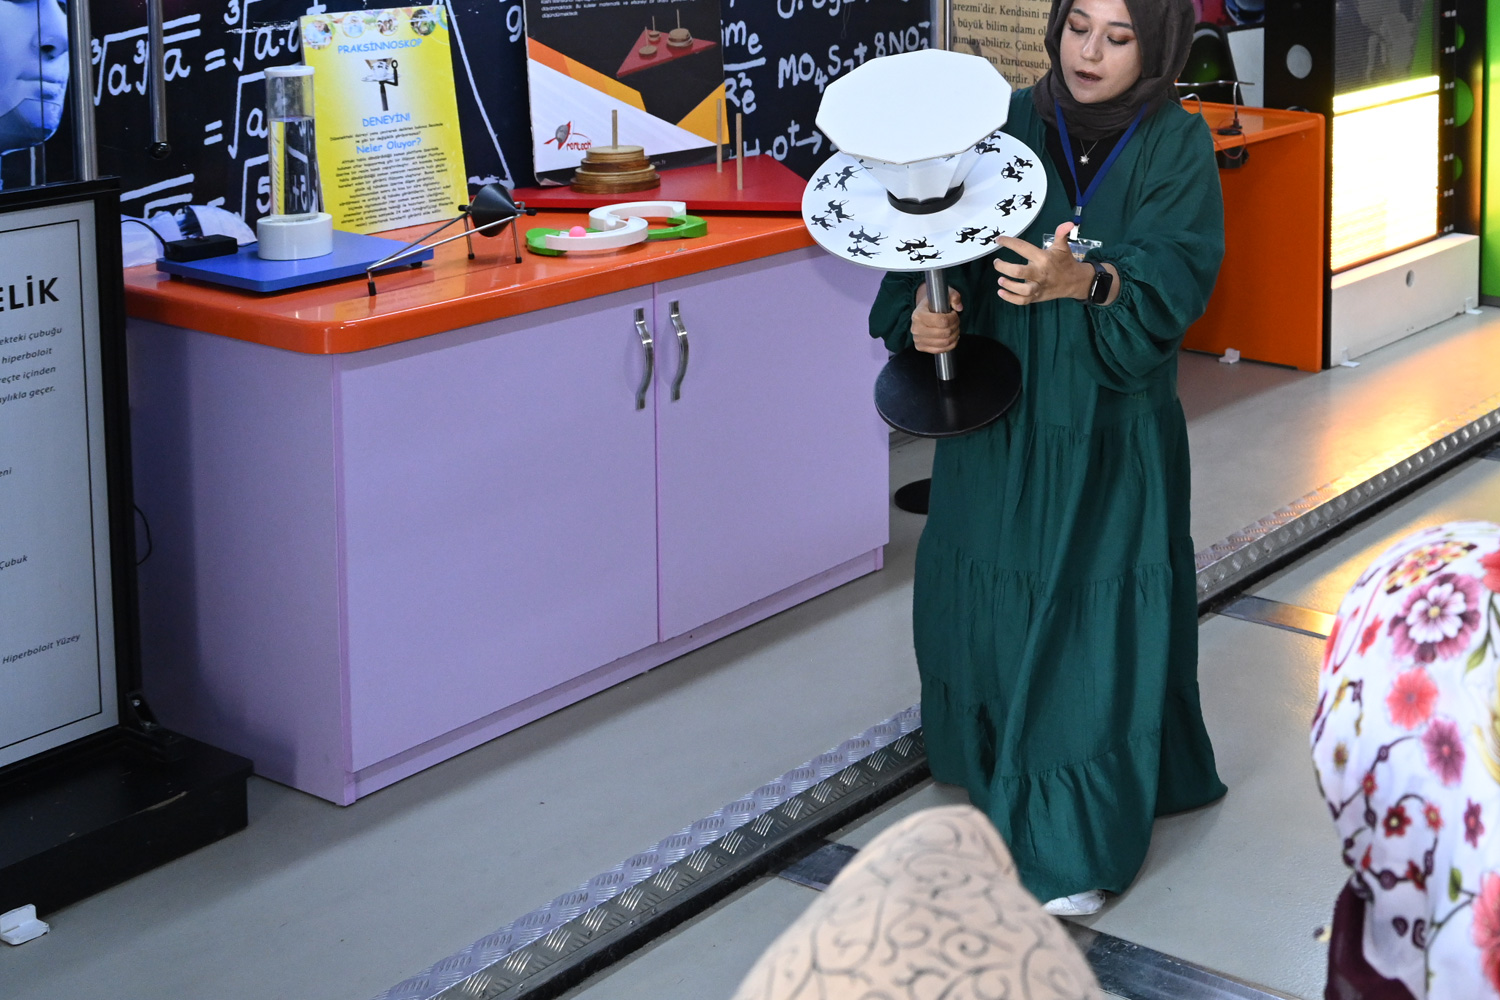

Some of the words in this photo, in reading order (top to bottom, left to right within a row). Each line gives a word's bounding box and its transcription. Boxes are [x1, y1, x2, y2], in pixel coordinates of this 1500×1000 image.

[952, 2, 997, 15] arezmi'dir.
[1000, 8, 1040, 20] Kendisini
[957, 17, 983, 31] büyük
[986, 20, 1008, 32] bilim
[953, 36, 1013, 50] nımlayabiliriz.
[1015, 40, 1044, 53] Çünkü
[356, 143, 383, 154] Neler
[386, 137, 422, 151] Oluyor?
[28, 327, 63, 342] çubuğu
[2, 347, 53, 365] hiperboloit
[23, 365, 56, 380] içinden
[2, 641, 54, 665] Hiperboloit
[56, 633, 81, 648] Yüzey
